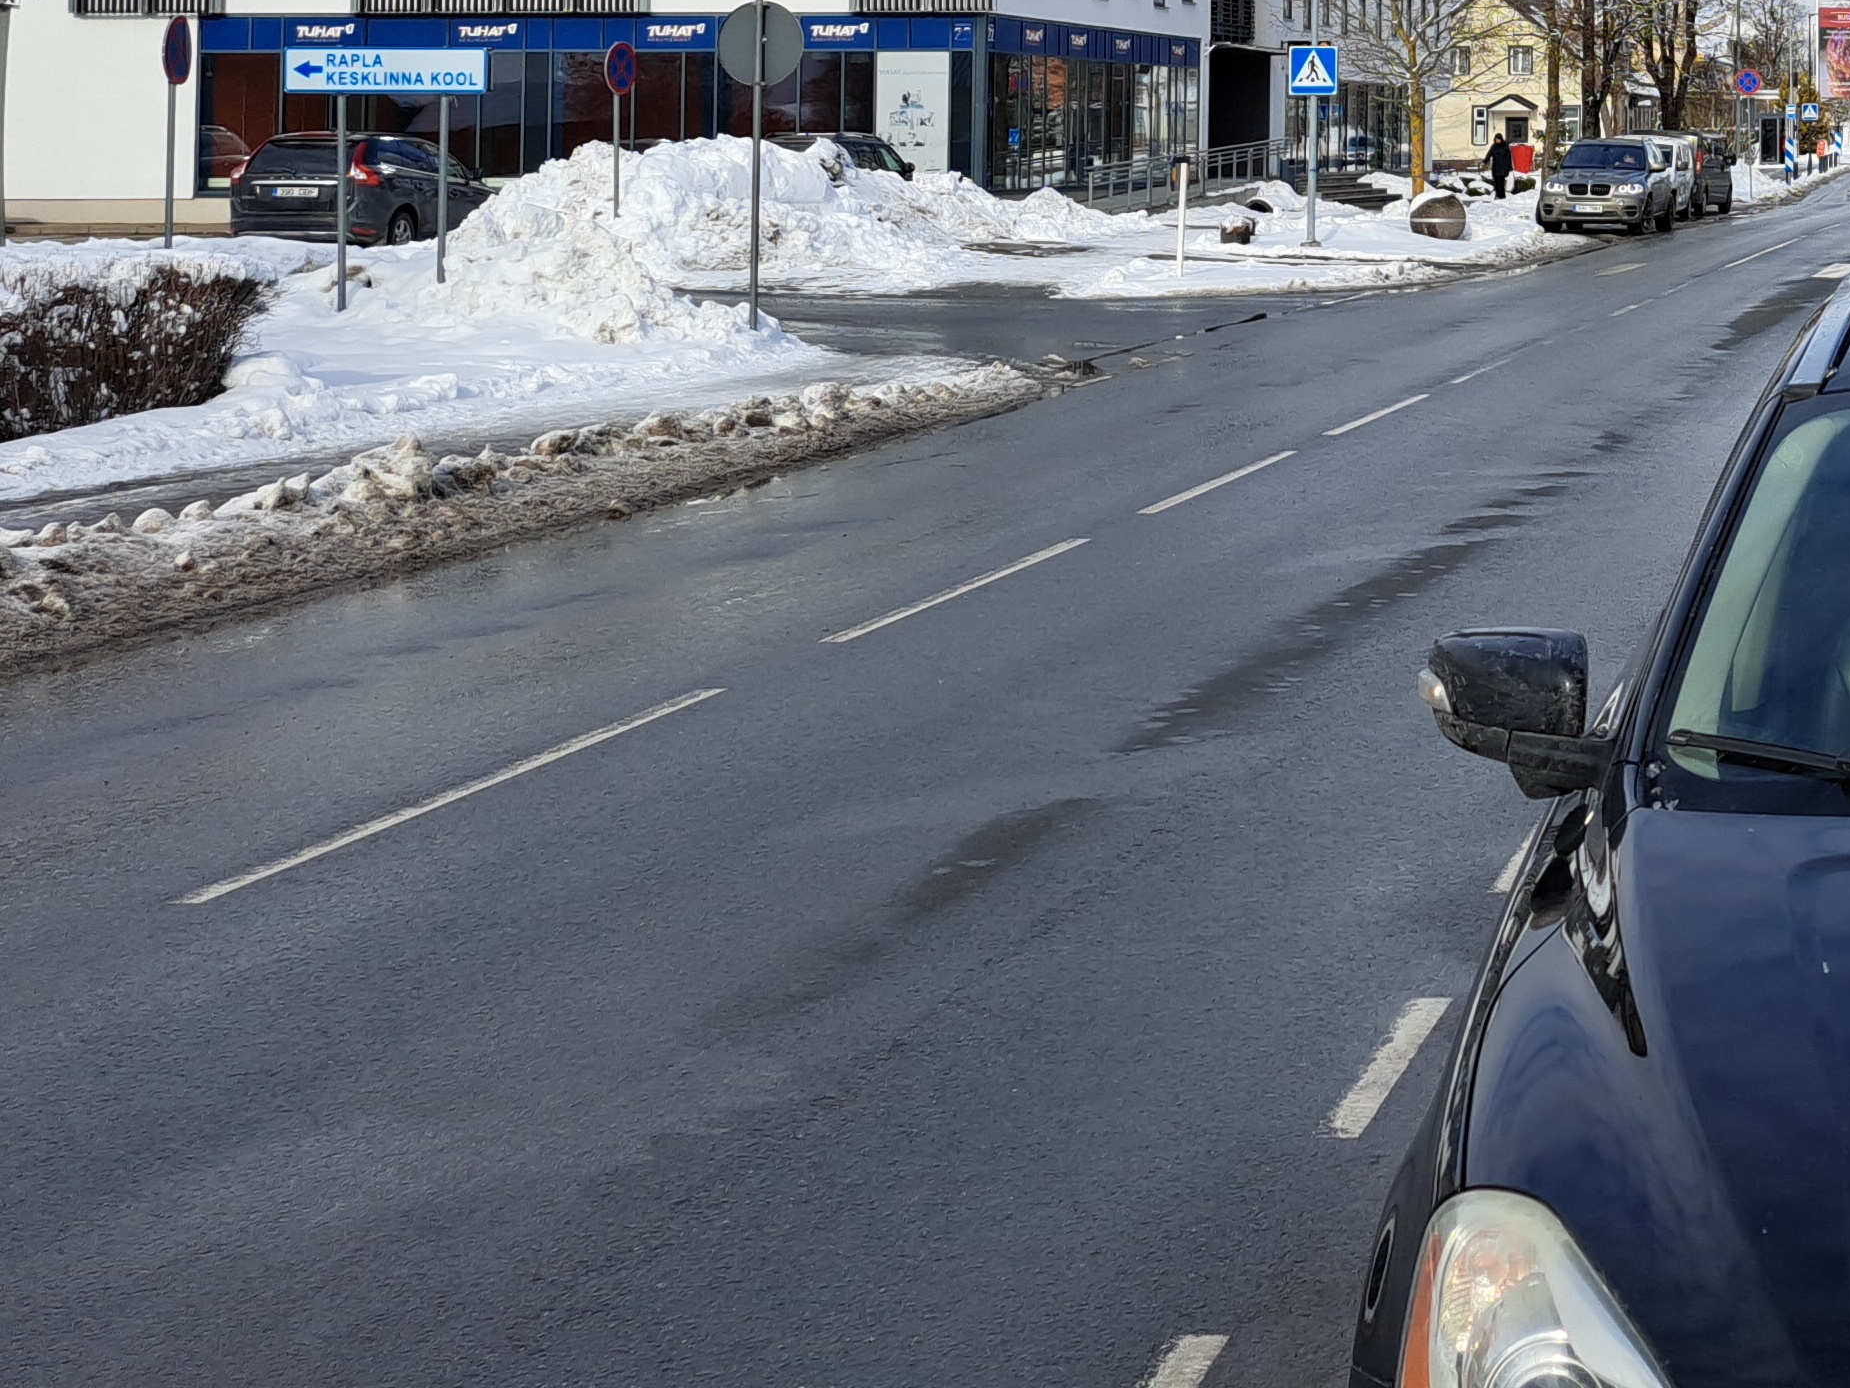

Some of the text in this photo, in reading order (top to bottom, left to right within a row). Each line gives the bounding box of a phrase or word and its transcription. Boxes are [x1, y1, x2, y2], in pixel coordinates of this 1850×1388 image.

[296, 25, 345, 38] TUHAT
[458, 25, 507, 37] TUHAT
[646, 25, 696, 37] TUHAT
[810, 24, 859, 37] TUHAT
[325, 53, 384, 68] RAPLA
[325, 71, 478, 86] KESKLINNA KOOL
